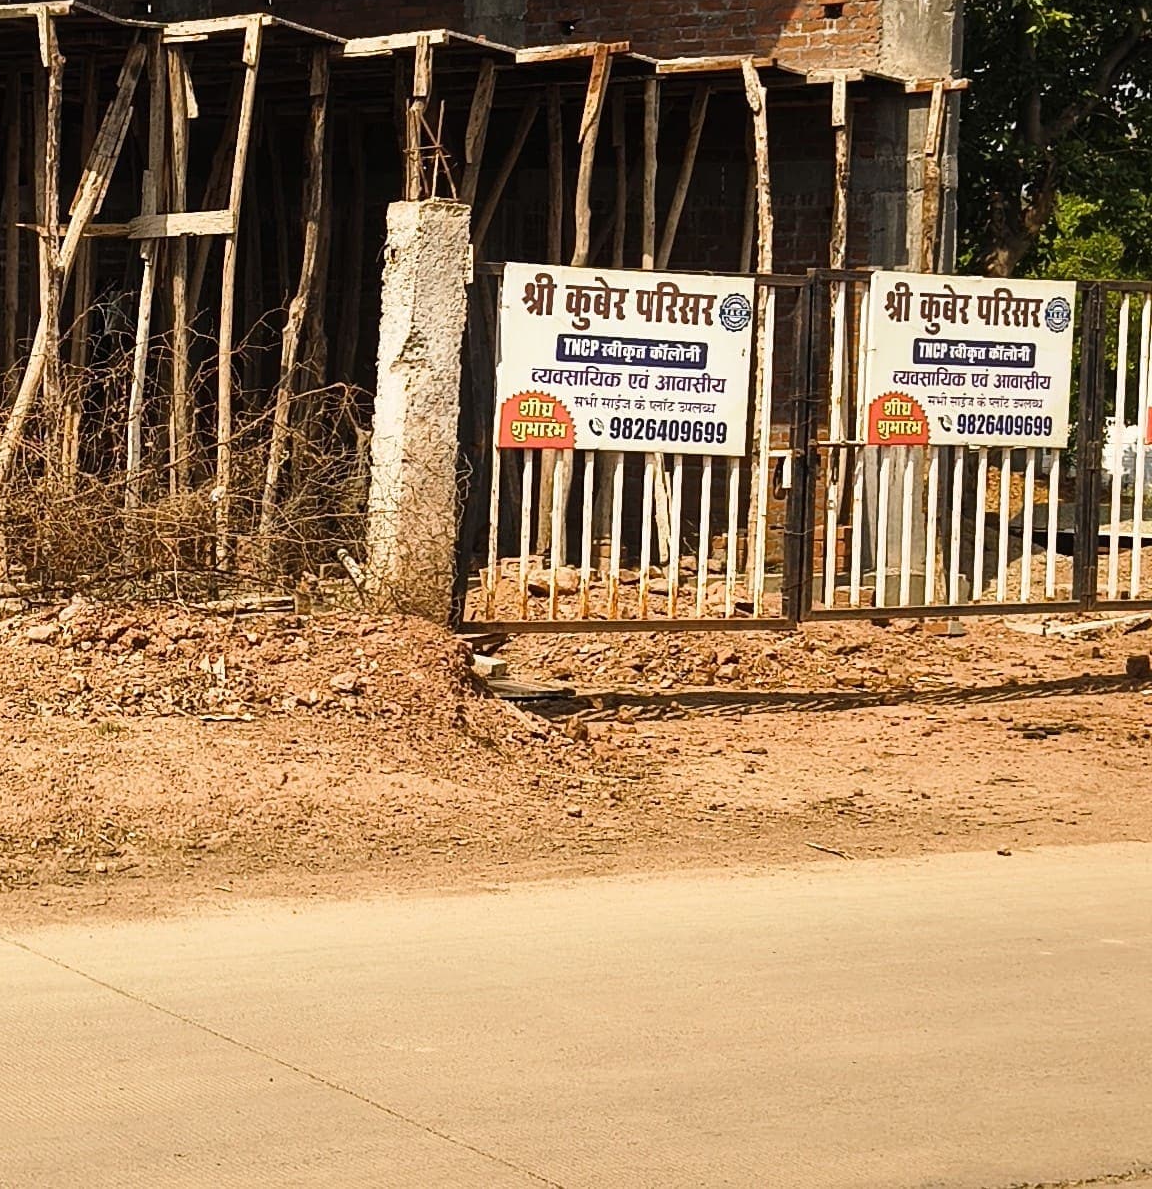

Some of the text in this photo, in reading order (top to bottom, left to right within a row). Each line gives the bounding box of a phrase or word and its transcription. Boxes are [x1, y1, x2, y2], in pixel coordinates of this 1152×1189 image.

[522, 273, 557, 315] श्री
[565, 277, 629, 330] कुबेर
[636, 282, 717, 325] परिसर
[884, 282, 913, 322] श्री
[920, 284, 972, 335] कुबेर
[977, 288, 1043, 327] परिसर
[564, 338, 701, 362] TNCP स्वीकृत कॉलोनी
[919, 342, 1031, 363] TNCP स्वीकृत कॉलोनी
[532, 366, 727, 393] व्यवसायिक एवं आवासीय
[893, 367, 1051, 390] व्यवसायिक एवं आवासीय
[512, 419, 567, 441] शुभारंभ
[610, 417, 727, 443] 9826409699
[957, 414, 1052, 436] 9826409699
